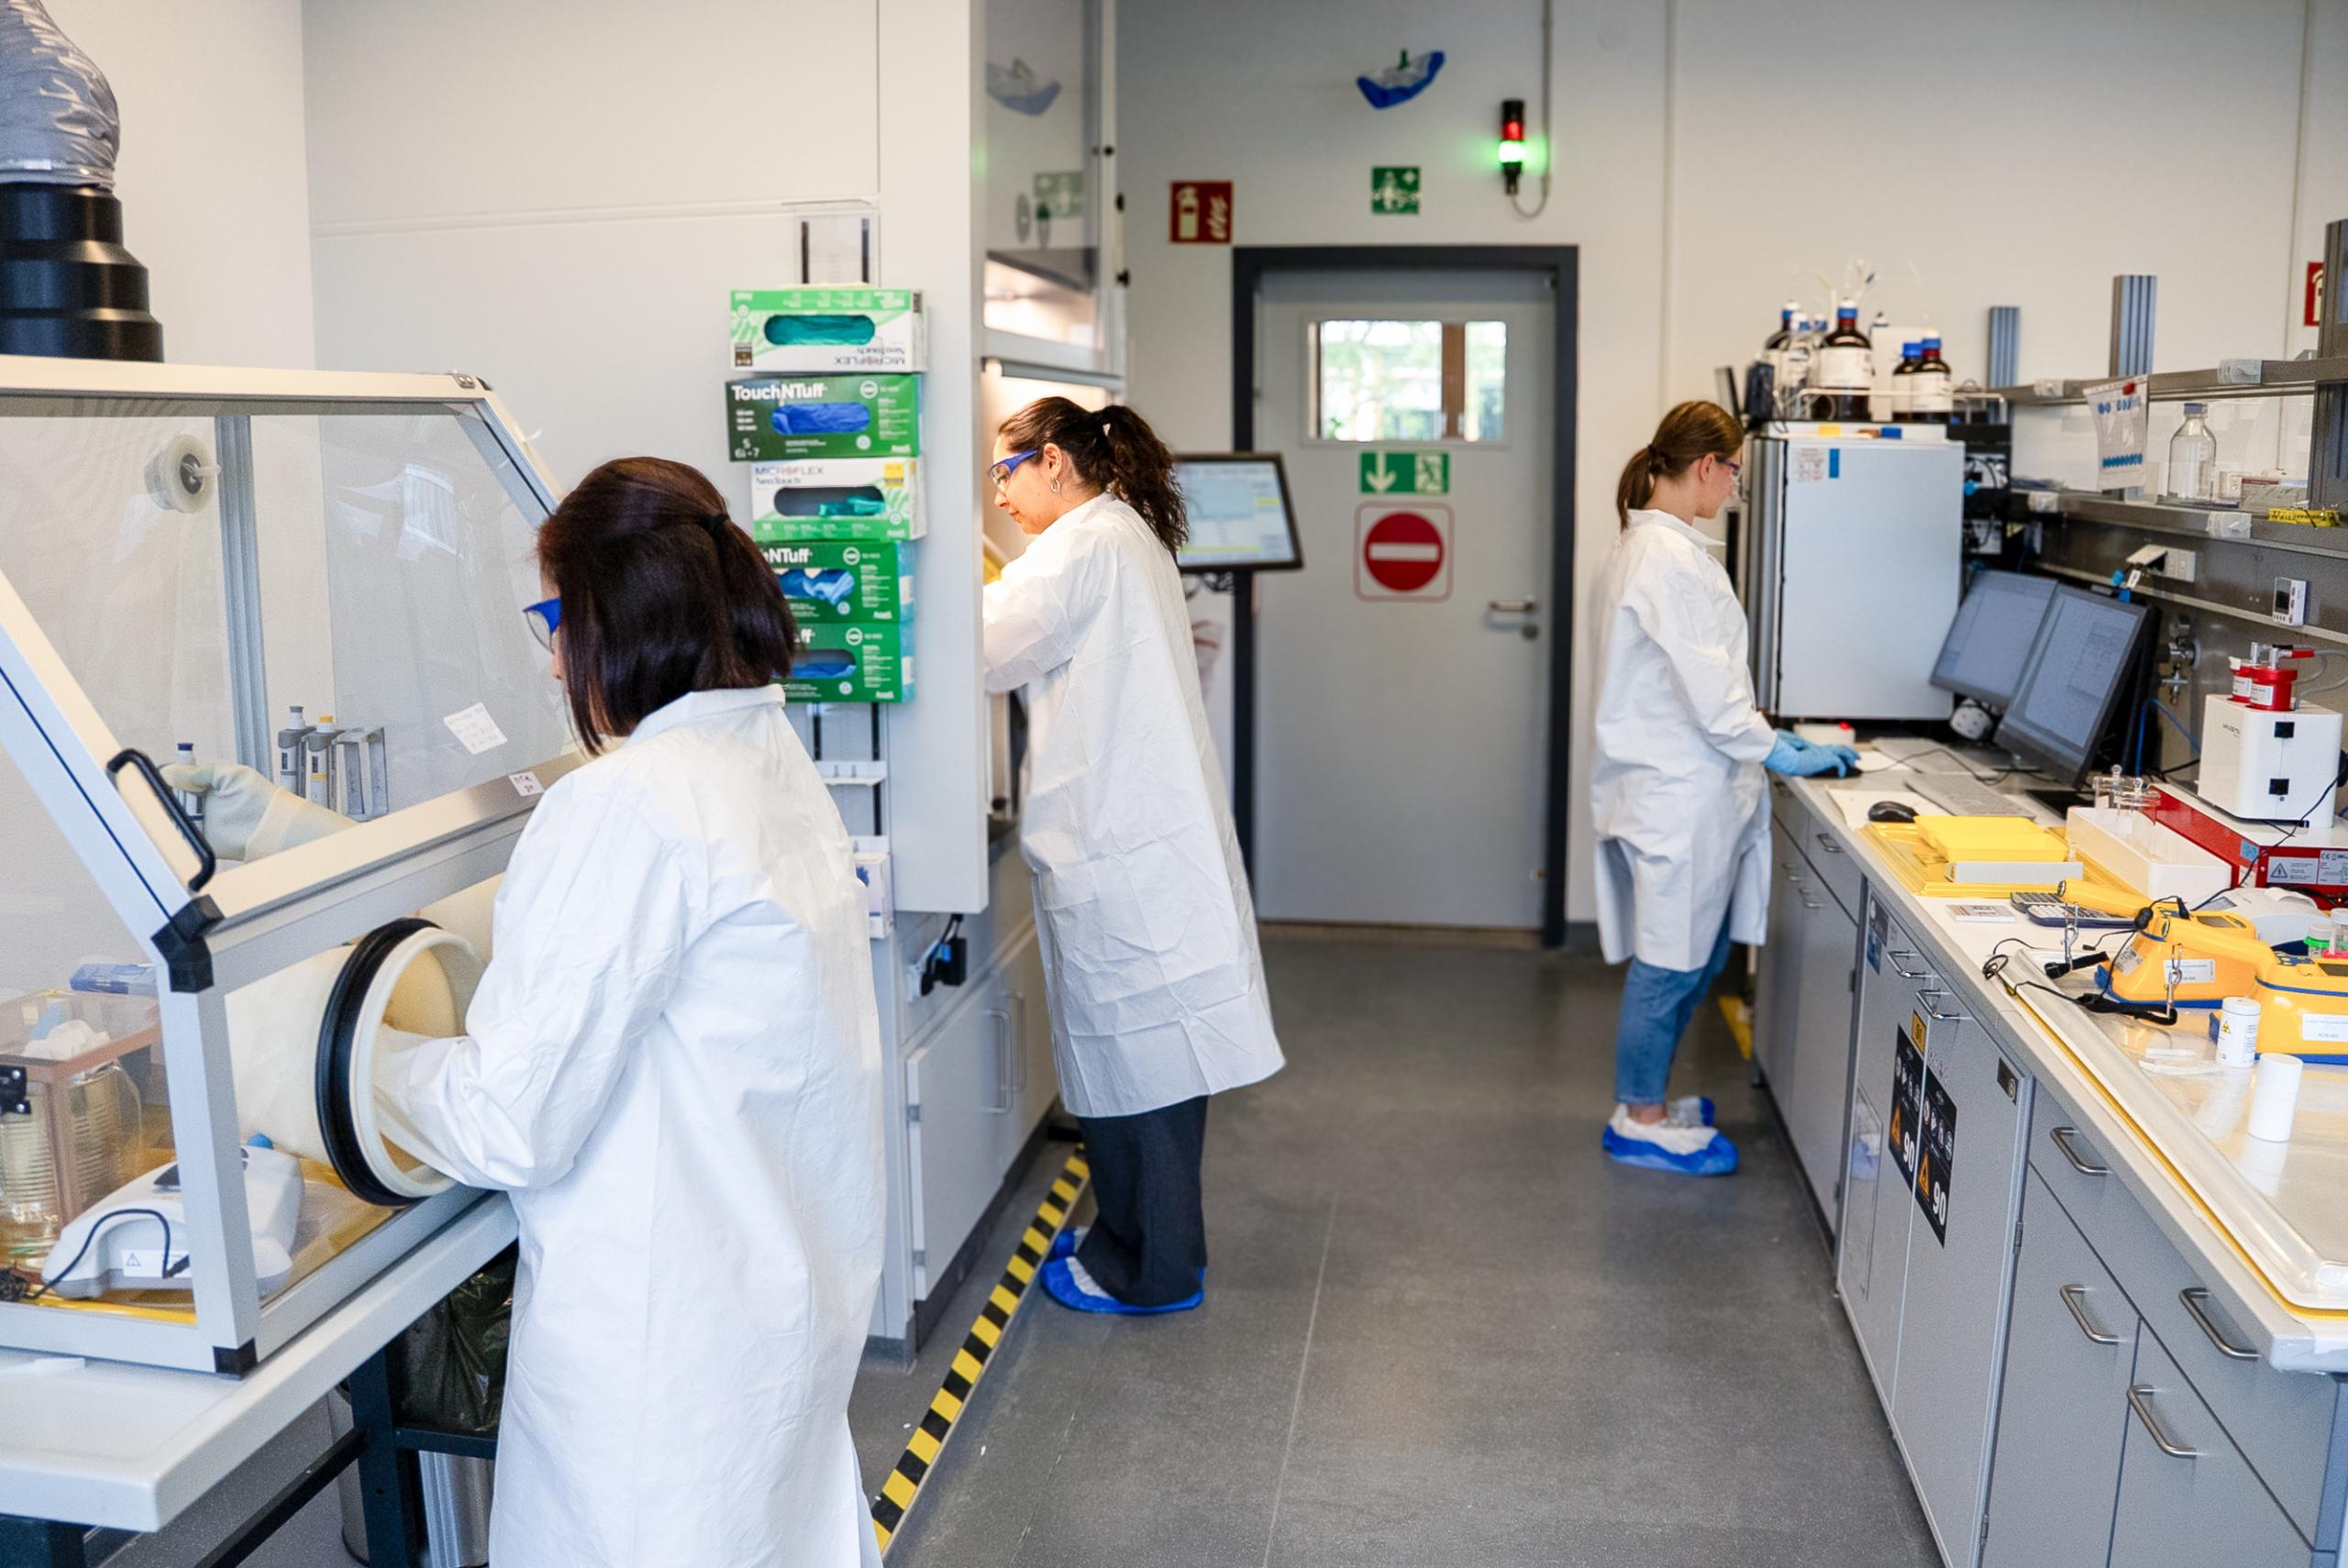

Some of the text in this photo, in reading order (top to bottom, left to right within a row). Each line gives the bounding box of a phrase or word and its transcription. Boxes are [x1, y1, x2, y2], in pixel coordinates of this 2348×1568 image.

[835, 356, 905, 366] MICROFLEX
[731, 383, 825, 401] TouchNTuff
[755, 466, 824, 475] MICROFLEX
[1903, 1131, 1915, 1173] 90
[1933, 1181, 1947, 1226] 90
